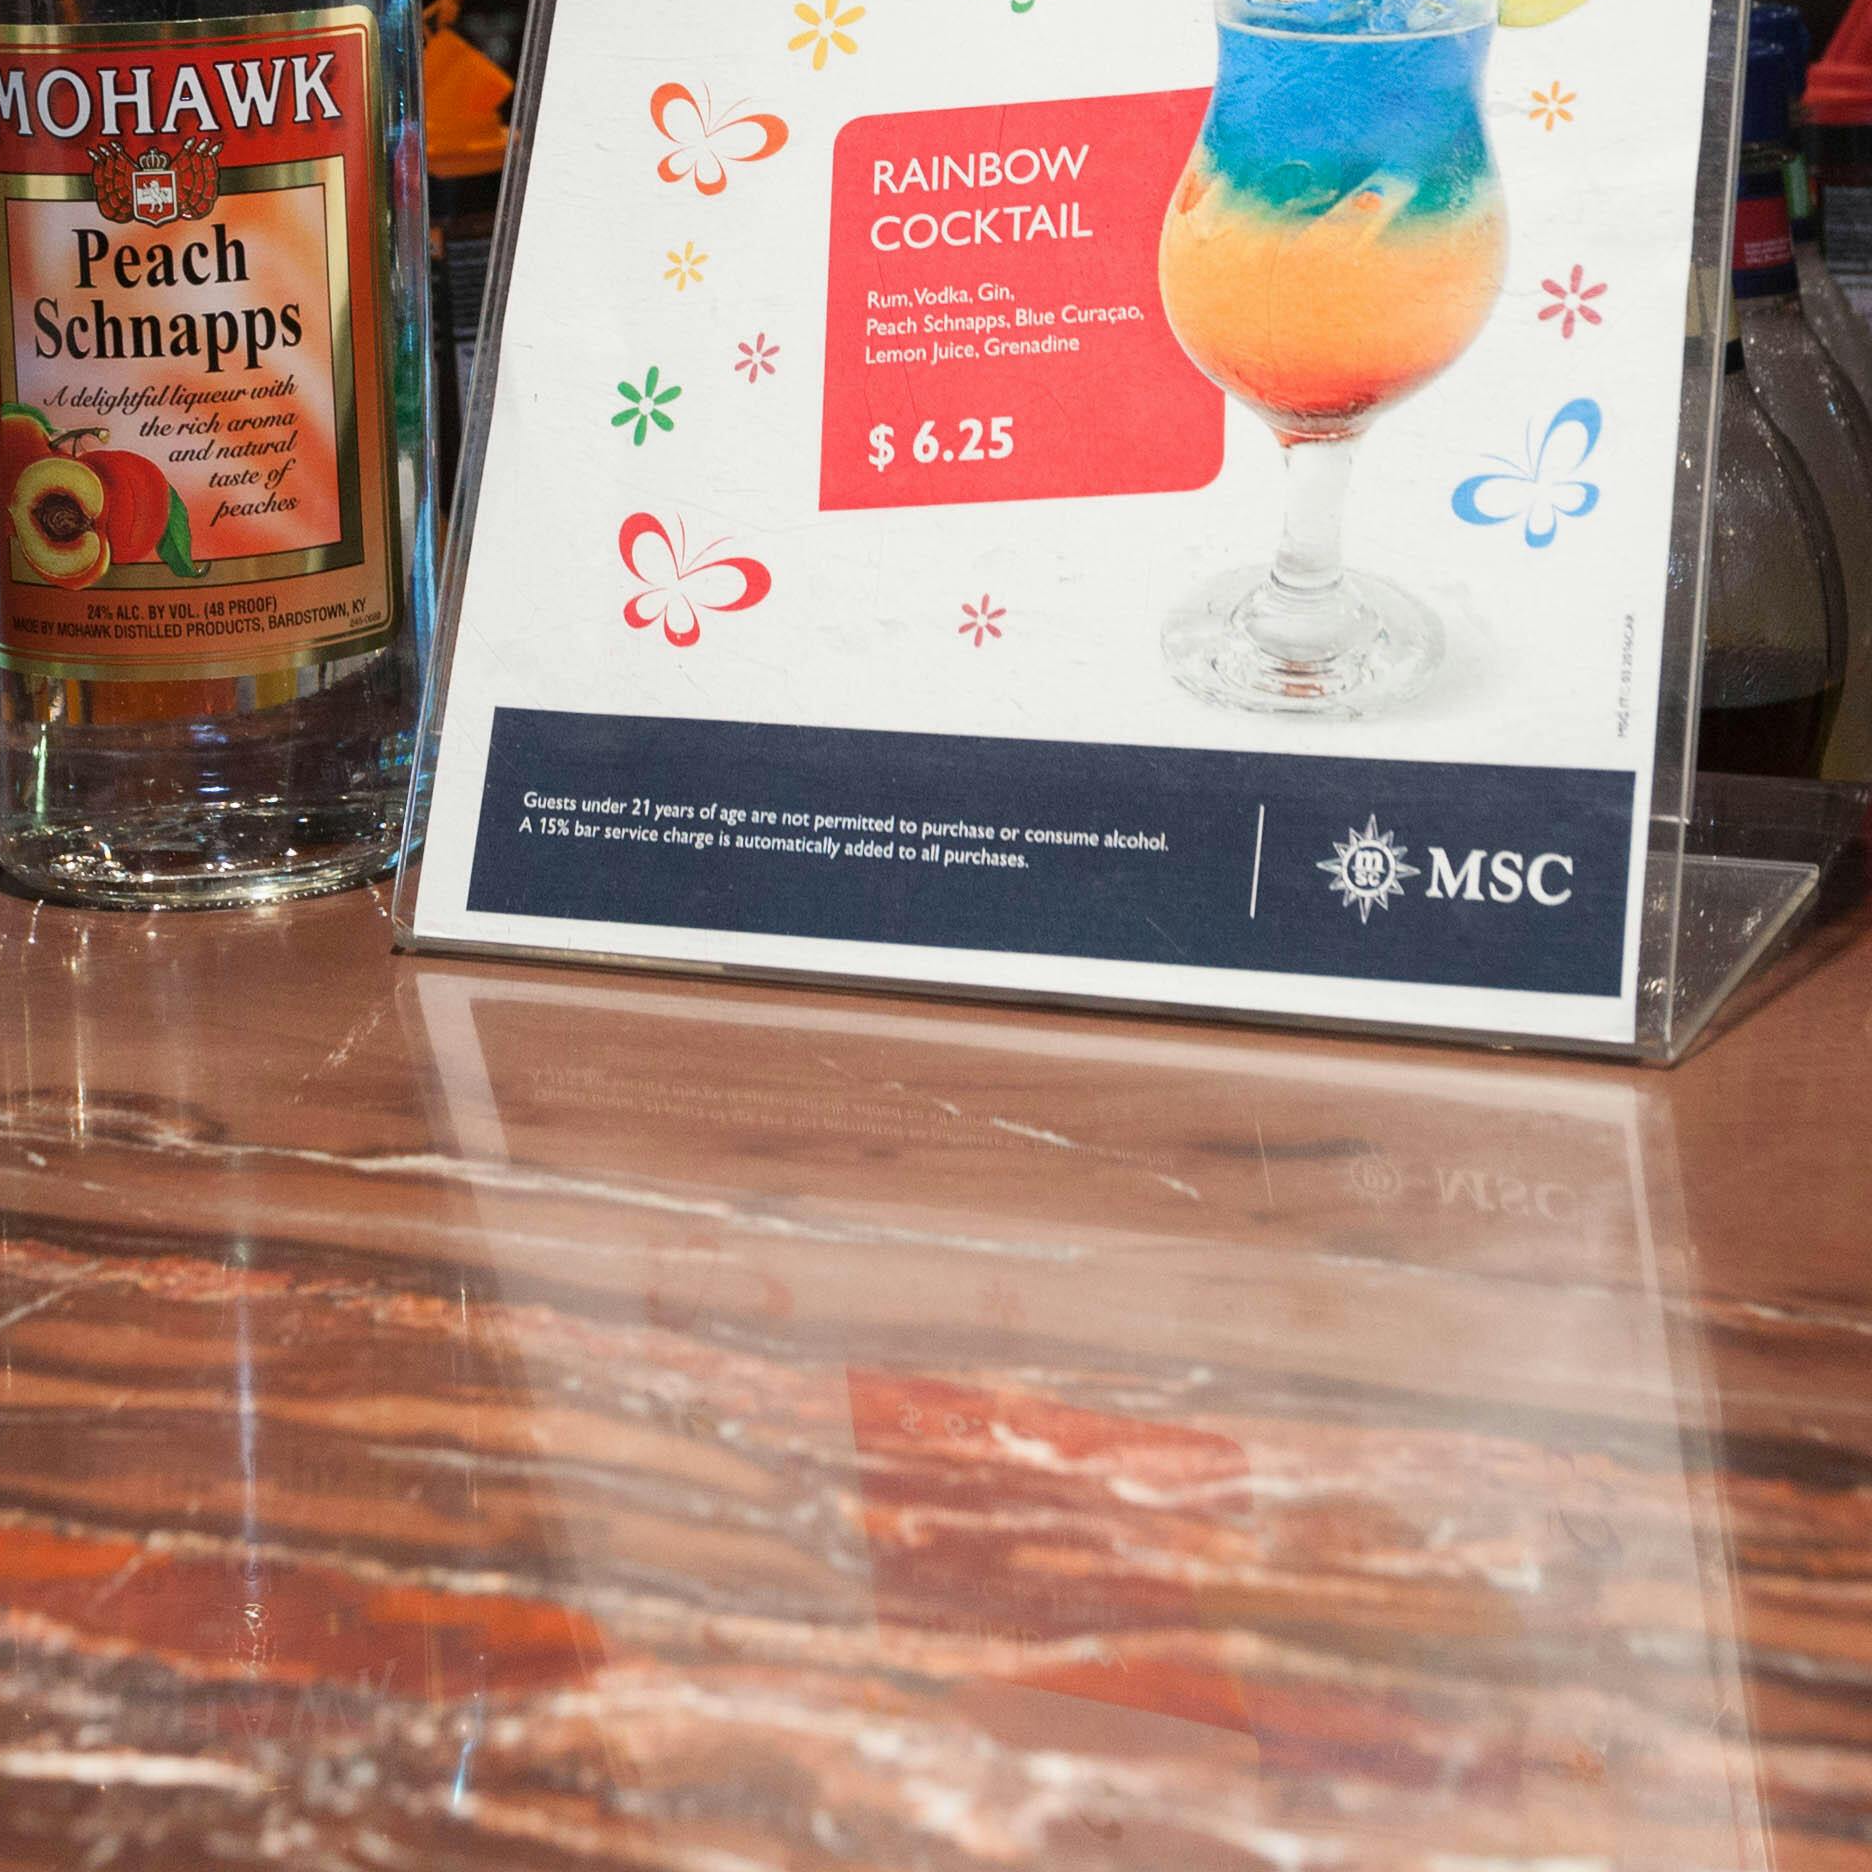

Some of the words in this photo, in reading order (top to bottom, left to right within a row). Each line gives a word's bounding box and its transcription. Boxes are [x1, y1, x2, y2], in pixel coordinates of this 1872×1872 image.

[873, 144, 1090, 196] RAINBOW
[870, 202, 1094, 252] COCKTAIL
[71, 223, 251, 290] Peach
[867, 289, 914, 310] Rum,
[913, 285, 975, 306] Vodka,
[977, 281, 1016, 302] Gin,
[34, 296, 303, 374] Schnapps
[866, 315, 918, 337] Peach
[922, 312, 1012, 335] Schnapps,
[1014, 307, 1056, 328] Blue
[1060, 302, 1146, 325] Curaçao,
[864, 345, 928, 366] Lemon
[930, 340, 981, 366] Juice,
[983, 334, 1081, 358] Grenadine
[42, 384, 69, 407] A
[70, 383, 173, 417] delightful
[171, 383, 248, 414] liqueur
[250, 373, 297, 400] with
[139, 415, 175, 438] the
[176, 411, 222, 437] rich
[227, 410, 297, 434] aroma
[867, 422, 896, 473] $
[911, 416, 1016, 466] 6.25
[169, 439, 215, 463] and
[216, 429, 299, 460] natural
[208, 470, 261, 489] taste
[264, 457, 297, 491] of
[209, 490, 299, 528] peaches
[57, 622, 112, 640] MOHAWK
[114, 623, 182, 640] DISTILLED
[186, 617, 265, 639] PRODUCTS,
[267, 602, 351, 631] BARDSTOWN,
[351, 597, 368, 614] KY
[86, 603, 115, 621] 24%
[117, 603, 145, 621] ALC.
[148, 603, 166, 621] BY
[168, 602, 200, 621] VOL.
[203, 600, 226, 619] (48
[228, 595, 279, 616] PROOF)
[518, 815, 533, 833] A
[539, 816, 570, 837] 15%
[574, 819, 601, 839] bar
[604, 825, 659, 844] service
[663, 828, 714, 851] charge
[718, 831, 732, 848] is
[734, 835, 842, 861] automatically
[844, 839, 895, 860] added
[898, 844, 918, 861] to
[921, 843, 940, 864] all
[944, 846, 1030, 871] purchases.
[523, 791, 577, 812] Guests
[581, 796, 627, 816] under
[631, 798, 651, 818] 21
[654, 802, 696, 823] years
[699, 802, 718, 821] of
[719, 807, 748, 828] age
[751, 810, 778, 826] are
[781, 810, 810, 829] not
[814, 812, 895, 833] permitted
[898, 818, 918, 836] to
[921, 819, 996, 841] purchase
[999, 826, 1021, 841] or
[1024, 827, 1100, 848] consume
[1103, 829, 1170, 853] alcohol.
[1424, 846, 1575, 907] MSC
